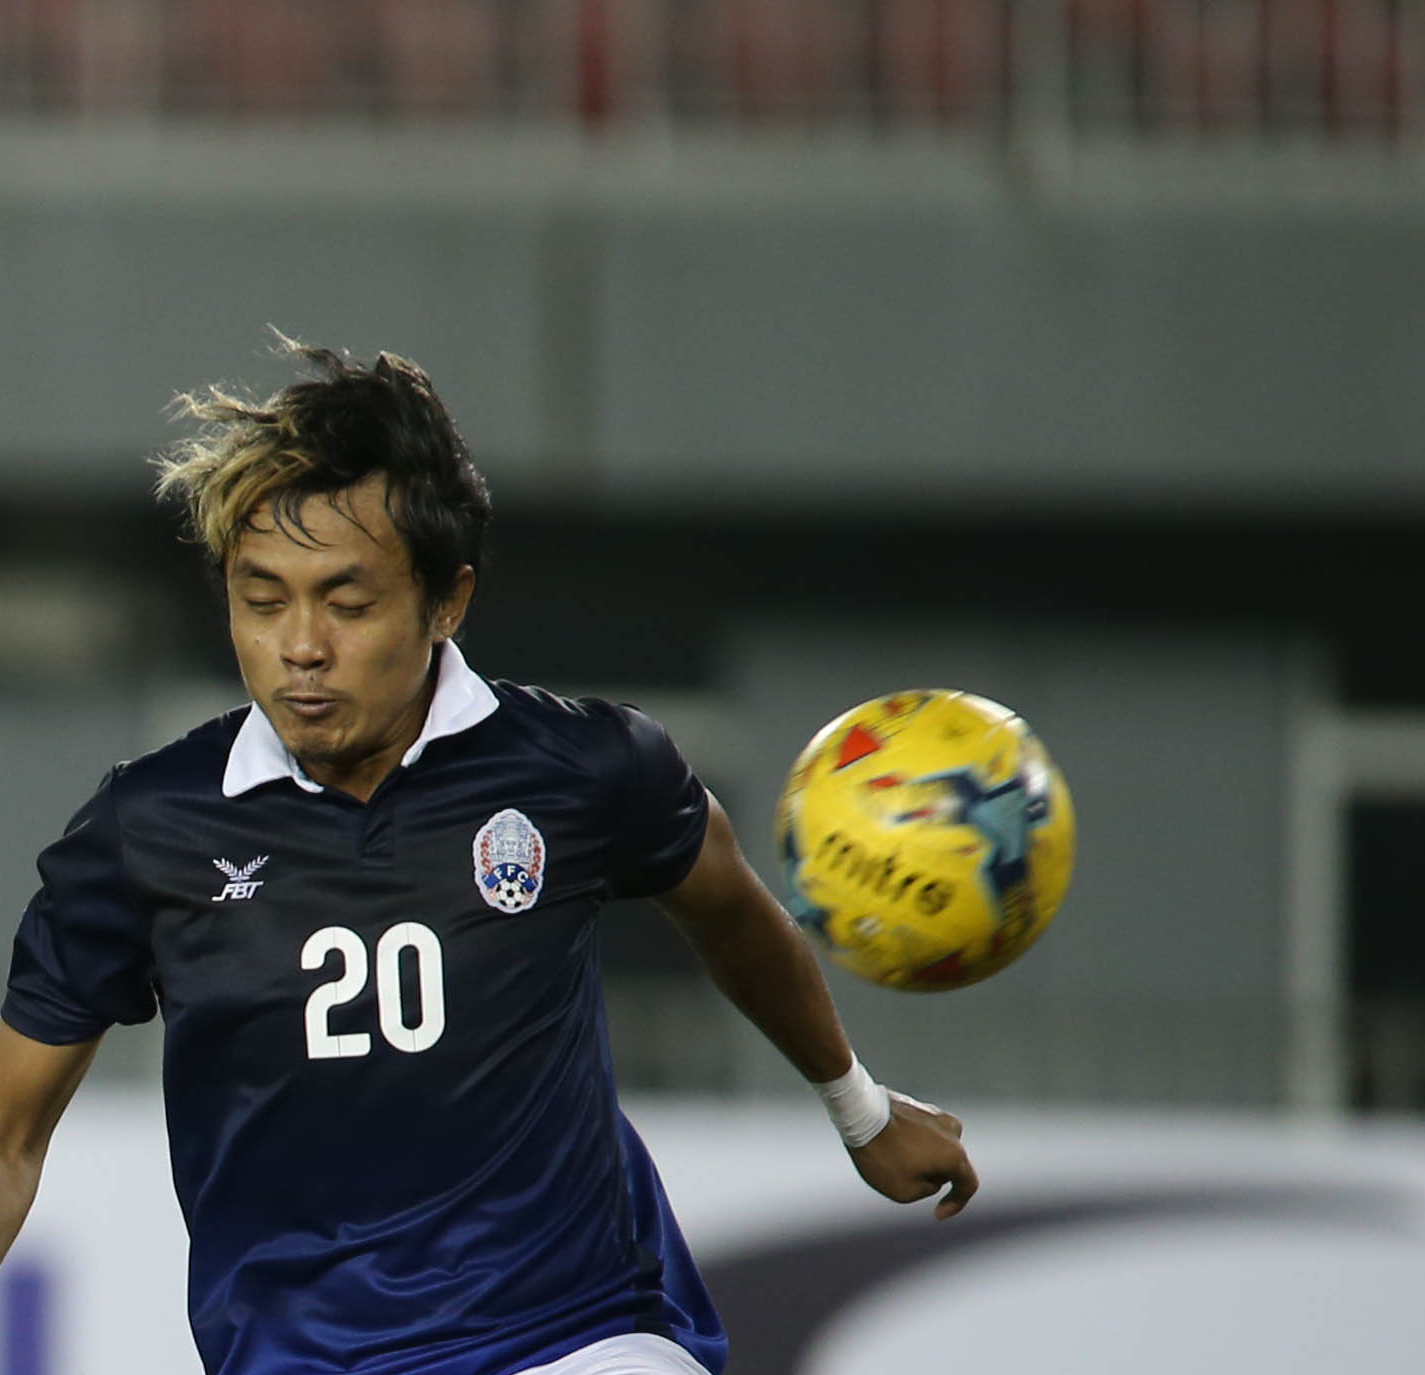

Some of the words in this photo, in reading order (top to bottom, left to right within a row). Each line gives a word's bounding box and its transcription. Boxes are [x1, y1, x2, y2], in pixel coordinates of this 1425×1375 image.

[493, 864, 530, 883] FFC
[211, 881, 264, 901] FBT
[300, 921, 446, 1060] 20
